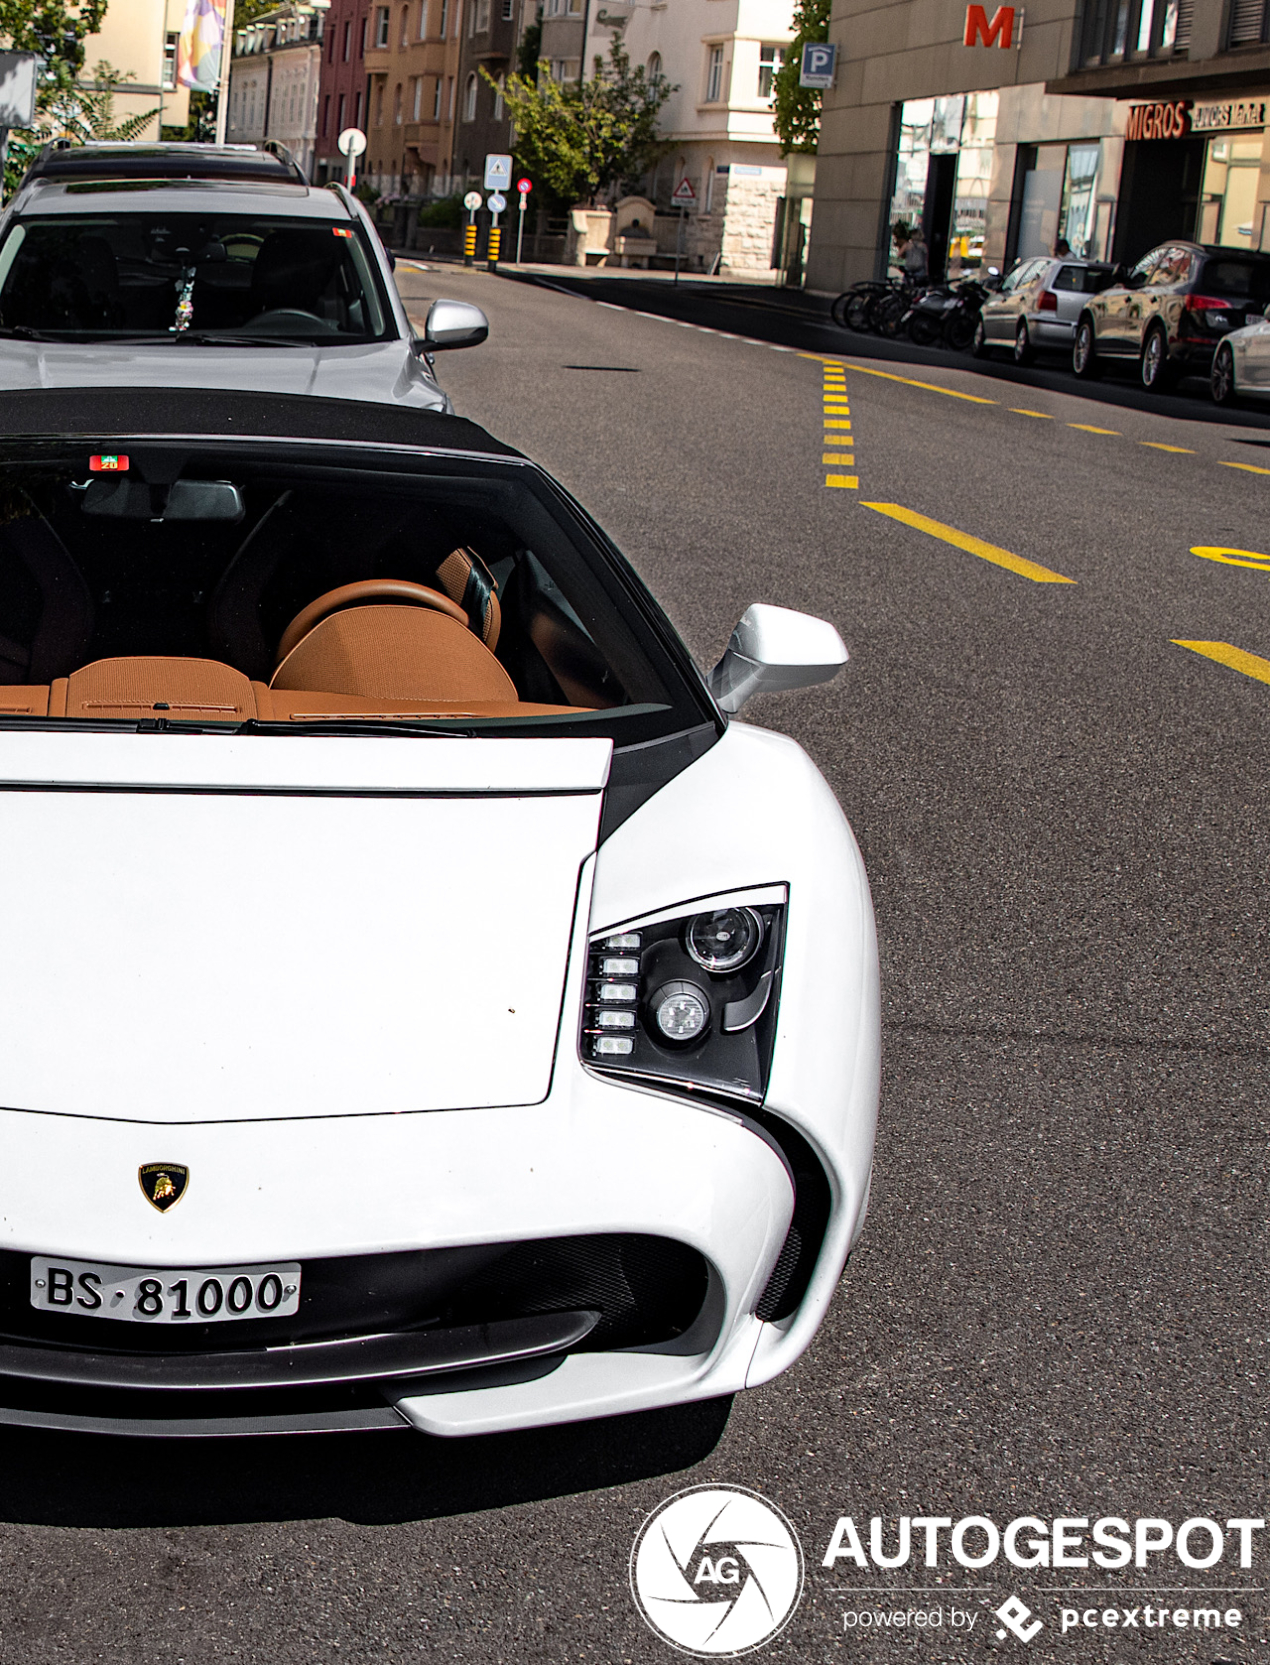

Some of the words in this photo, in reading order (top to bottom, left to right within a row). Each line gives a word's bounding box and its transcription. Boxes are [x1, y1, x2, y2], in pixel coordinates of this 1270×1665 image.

[963, 4, 1015, 49] M
[811, 51, 829, 72] P
[1125, 101, 1186, 140] MIGROS
[141, 1164, 186, 1175] LAMBORGHINI
